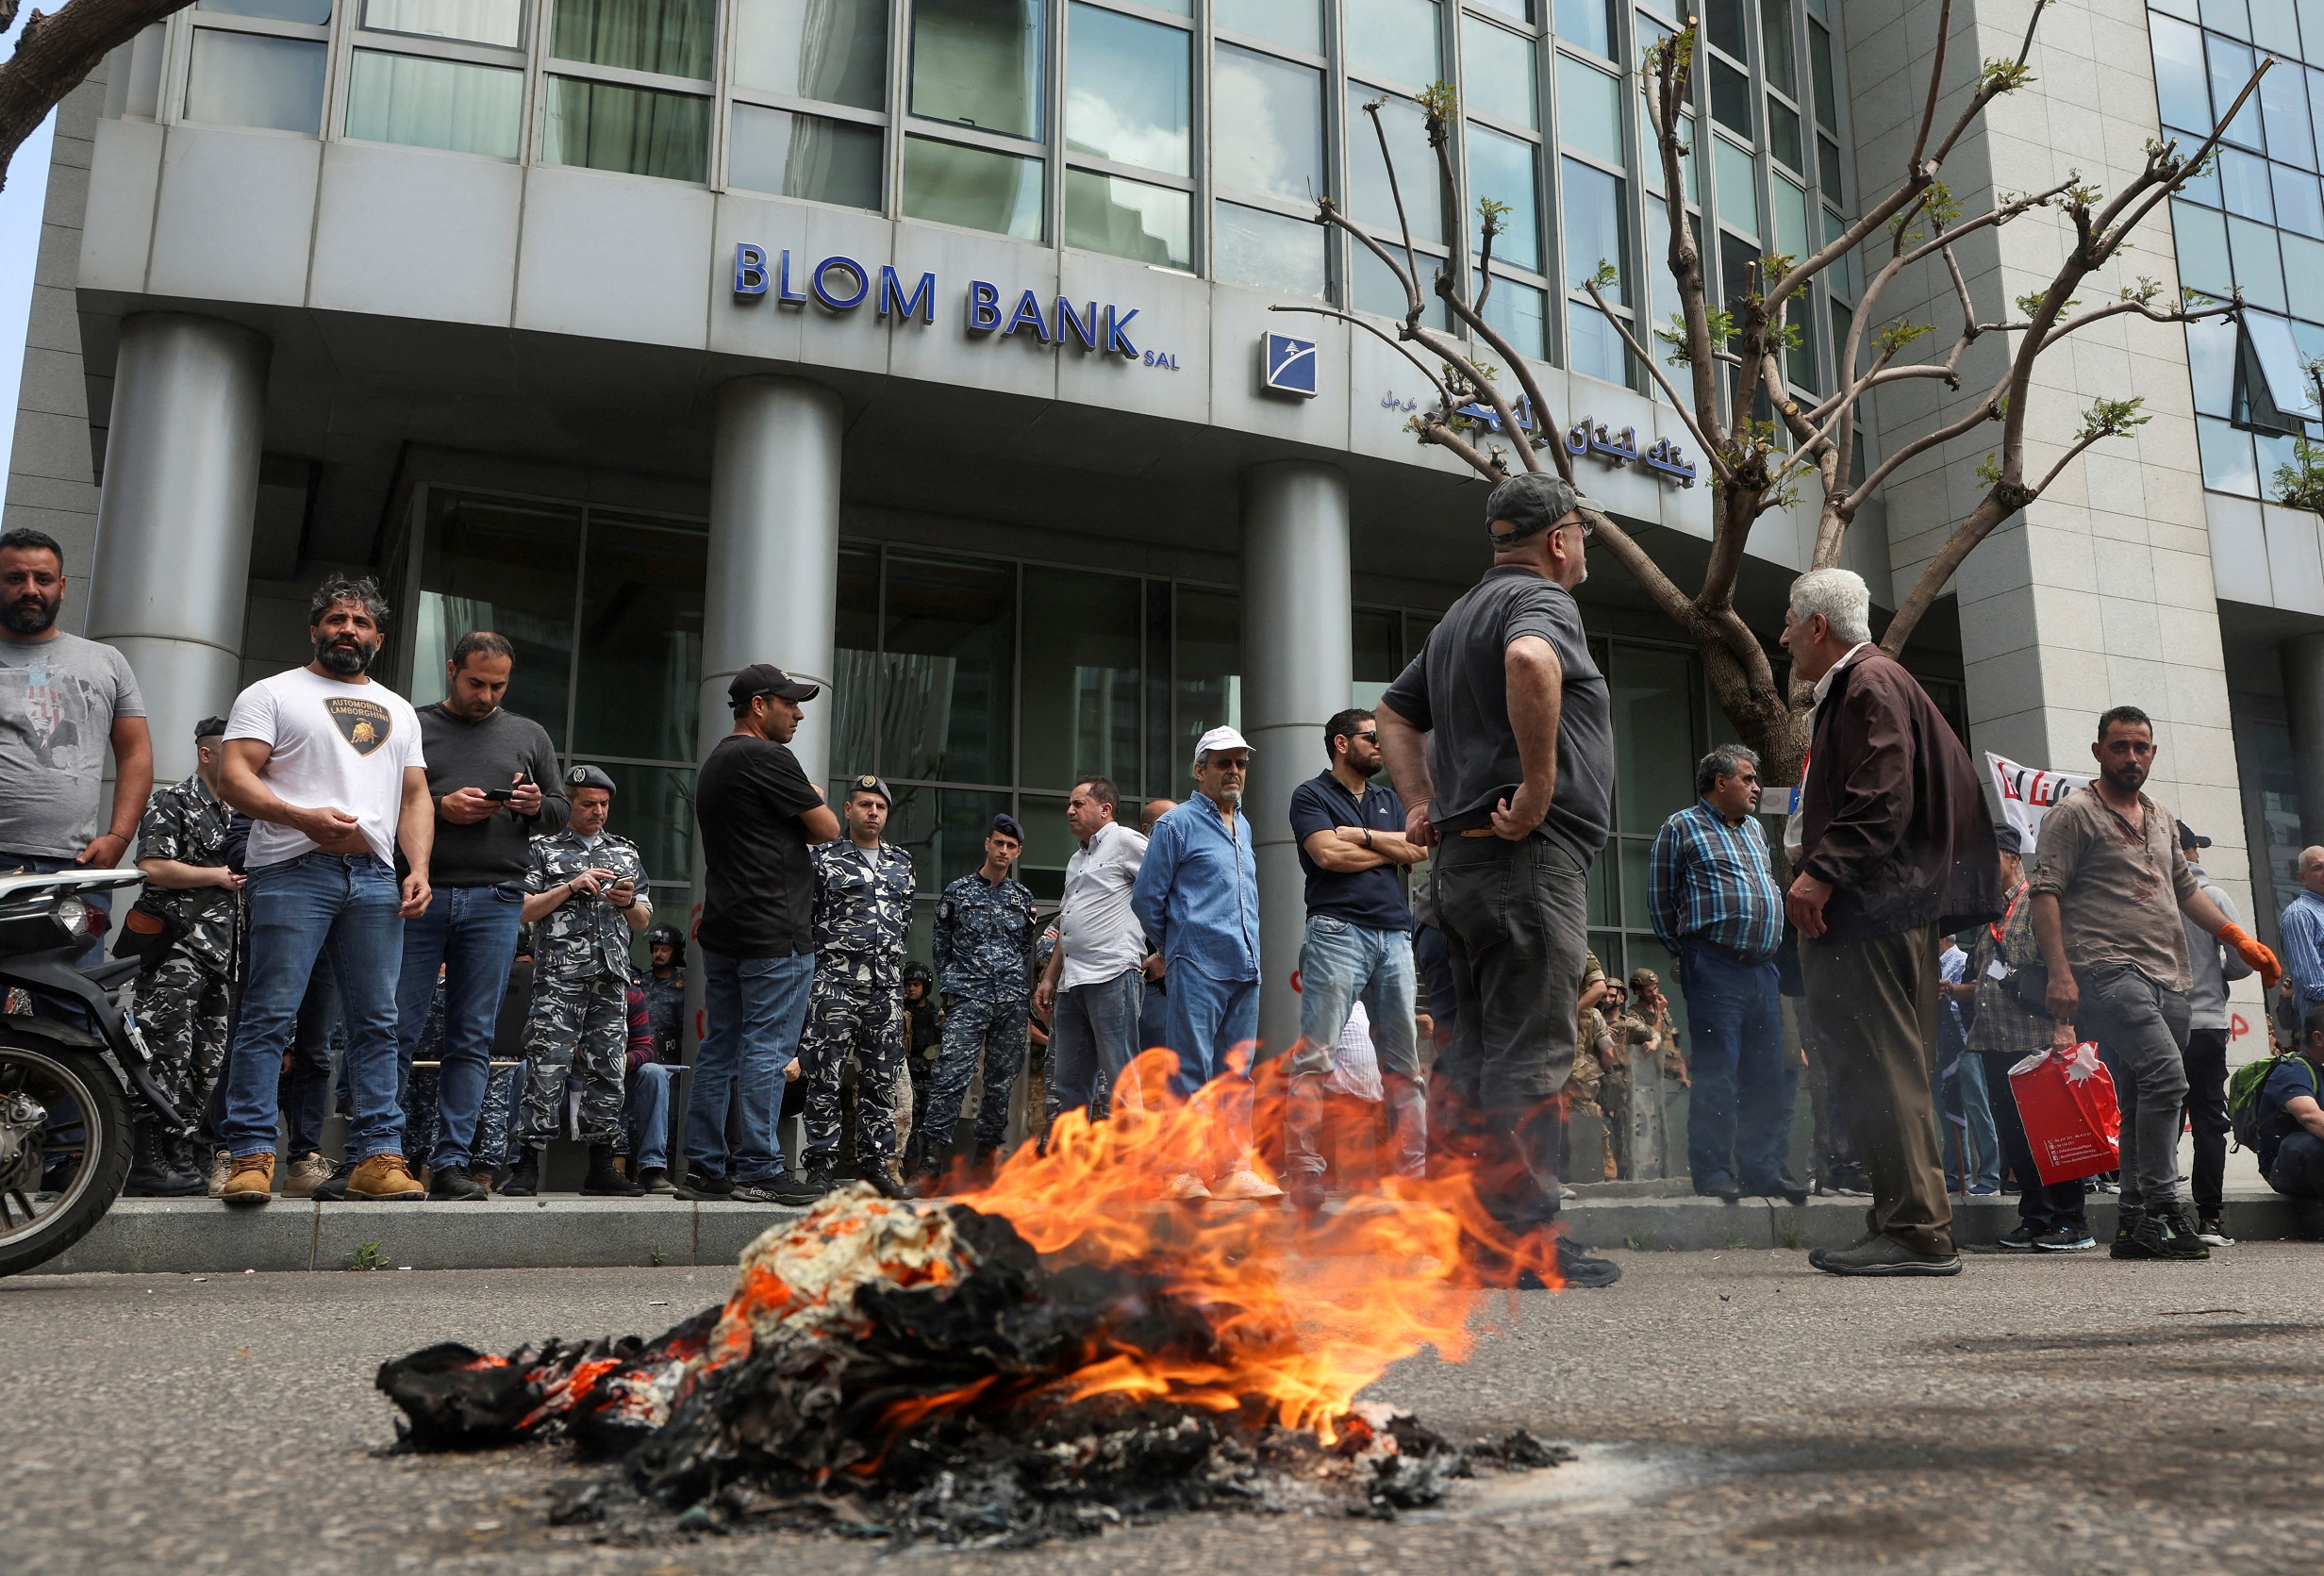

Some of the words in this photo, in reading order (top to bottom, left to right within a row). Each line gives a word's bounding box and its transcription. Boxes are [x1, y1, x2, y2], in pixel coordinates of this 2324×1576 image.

[734, 241, 936, 323] BLOM
[968, 279, 1139, 358] BANK
[1143, 350, 1180, 371] SAL
[1565, 414, 1637, 467] لبنان
[1645, 436, 1696, 488] بنك
[330, 706, 389, 722] LAMBORGHINI
[332, 699, 383, 714] AUTOMOBILI
